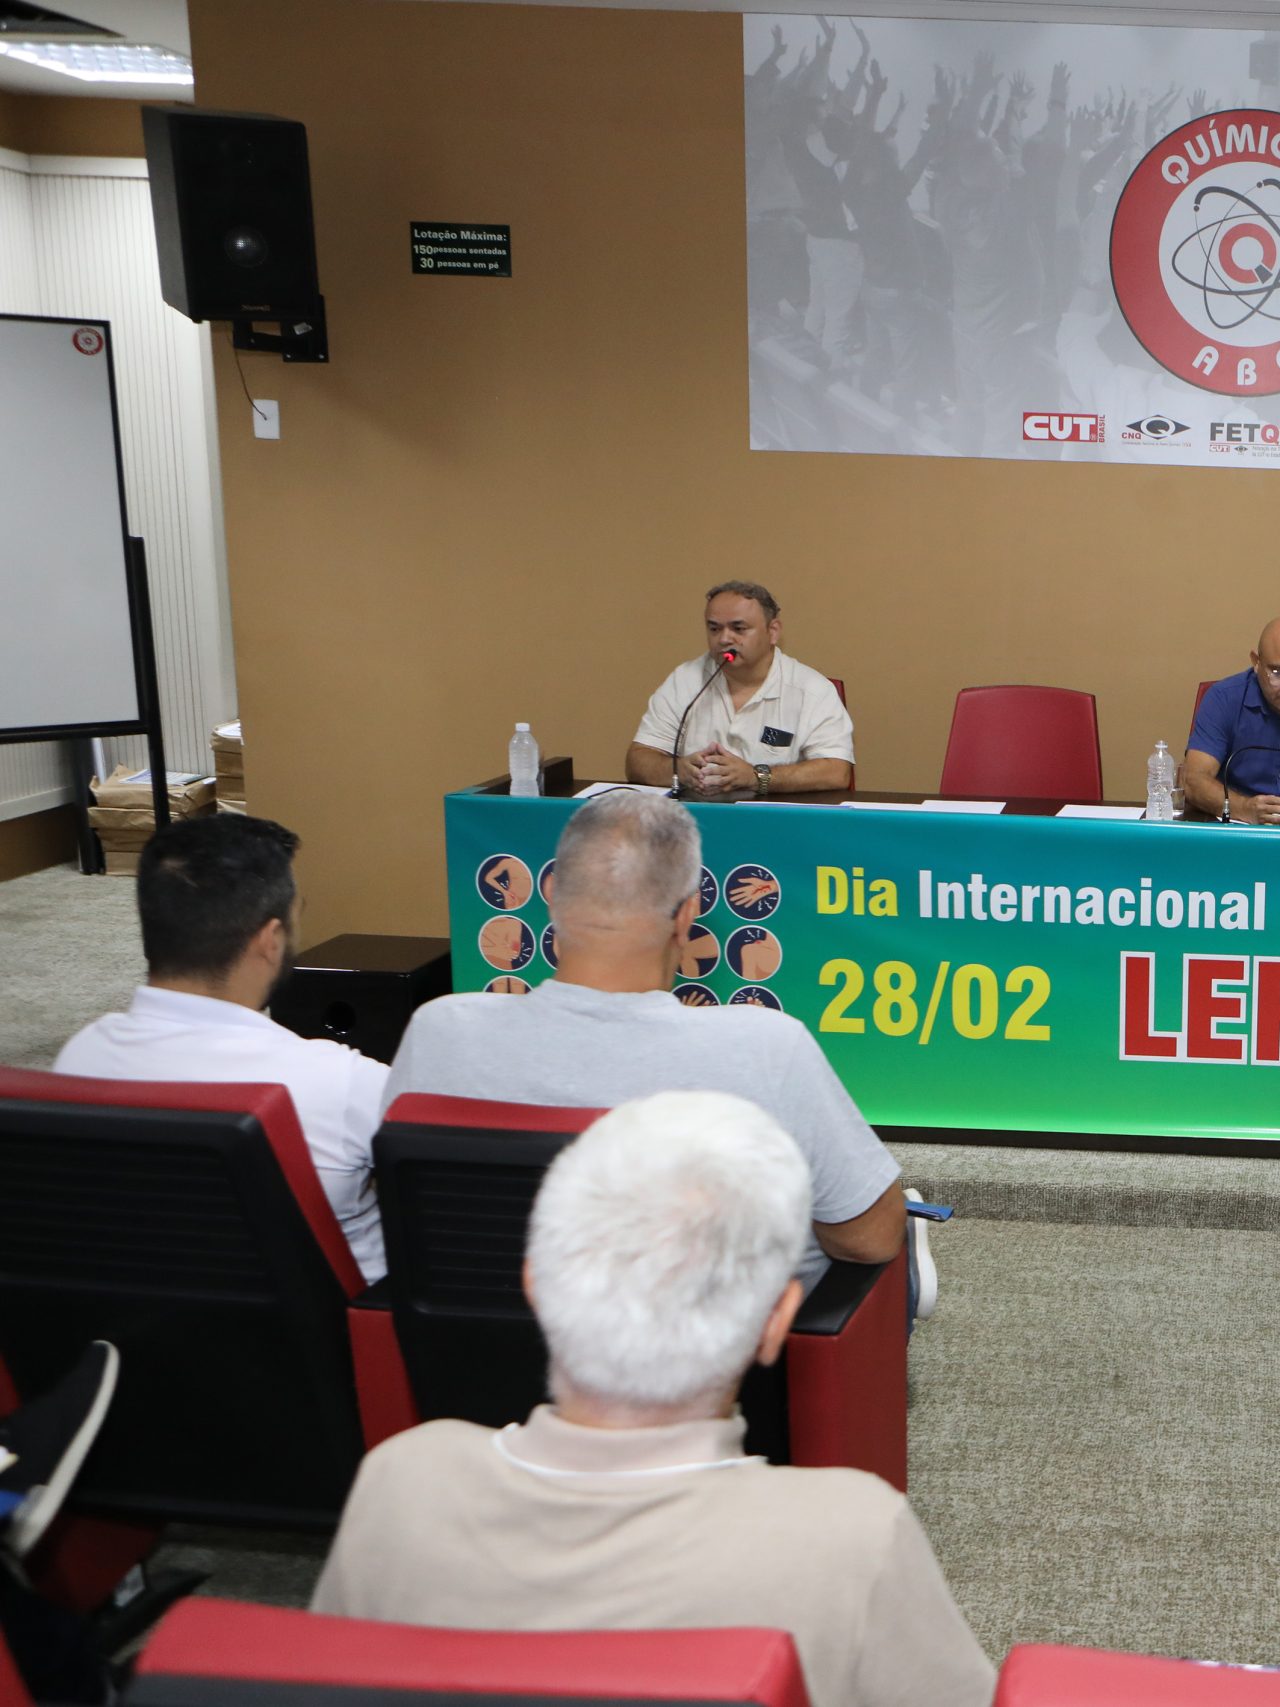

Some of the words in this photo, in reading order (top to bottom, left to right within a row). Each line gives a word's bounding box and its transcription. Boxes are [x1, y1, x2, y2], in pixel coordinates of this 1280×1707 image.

[414, 229, 458, 241] Lotação
[460, 230, 507, 241] Máxima:
[469, 247, 507, 255] sentadas
[420, 257, 434, 268] 30
[437, 260, 471, 268] pessoas
[488, 262, 499, 270] pé
[1121, 432, 1142, 440] CNQ
[816, 866, 898, 917] Dia
[918, 870, 1266, 931] Internacional
[818, 958, 1051, 1045] 28/02
